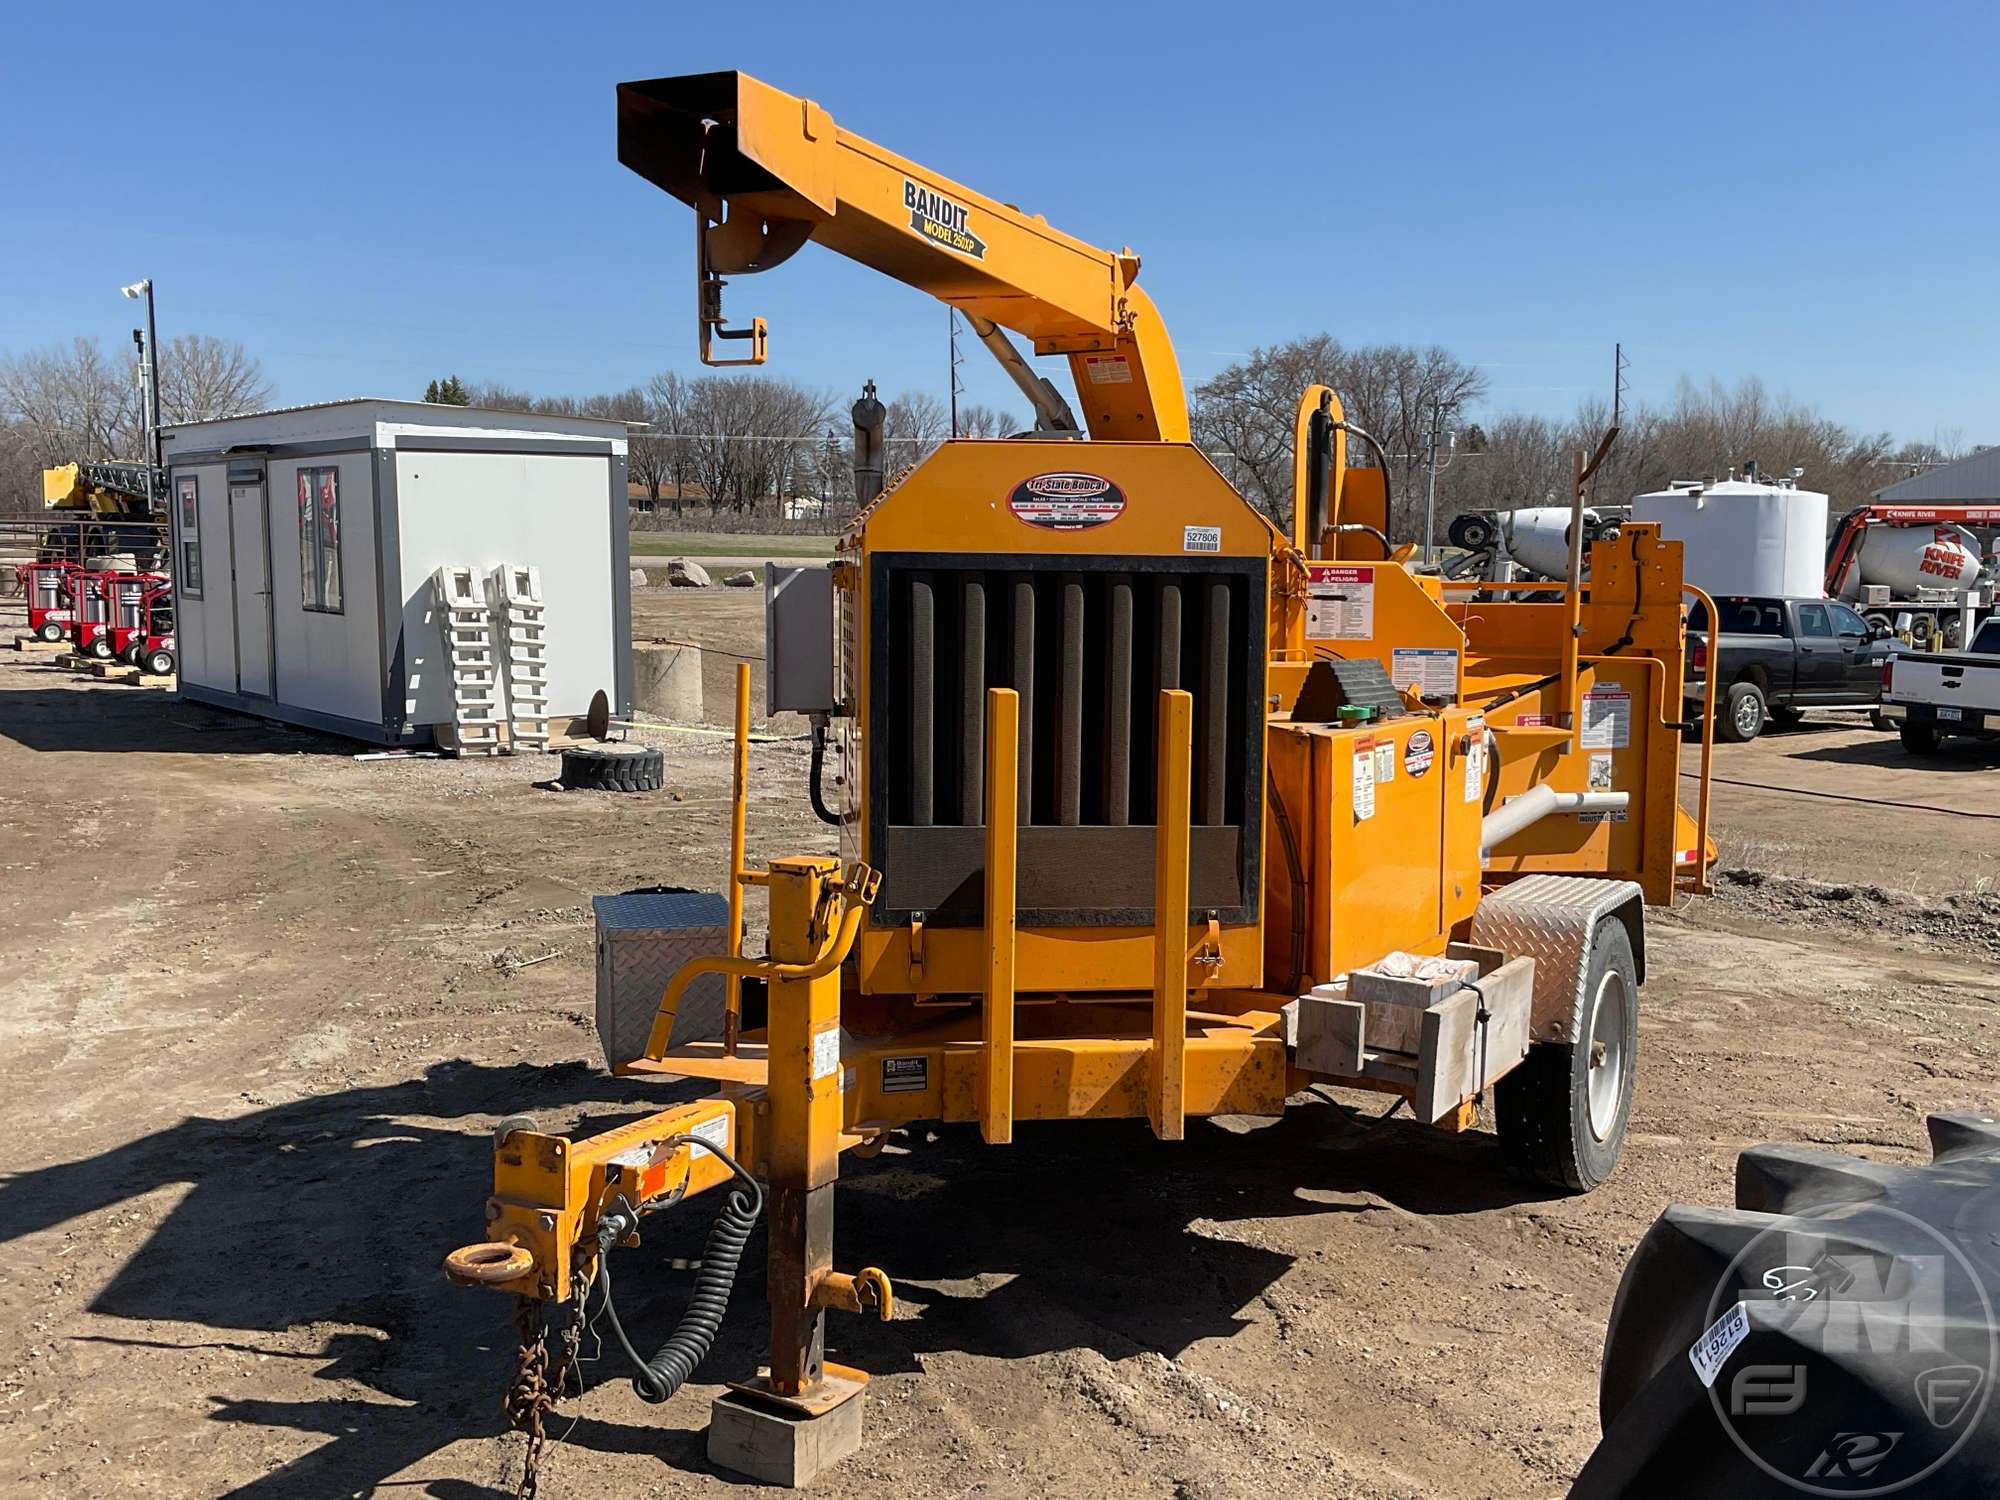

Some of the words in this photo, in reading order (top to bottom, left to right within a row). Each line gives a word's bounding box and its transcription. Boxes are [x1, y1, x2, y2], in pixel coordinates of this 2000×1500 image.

[905, 180, 968, 234] BANDIT
[923, 219, 952, 244] MODEL
[953, 233, 975, 252] 250XP
[1029, 479, 1069, 491] Tri-State
[1071, 479, 1106, 491] Bobcat
[1186, 532, 1218, 542] 527806
[1924, 546, 1966, 567] KNIFE
[1919, 559, 1962, 580] RIVER
[1699, 1316, 1744, 1371] 612611
